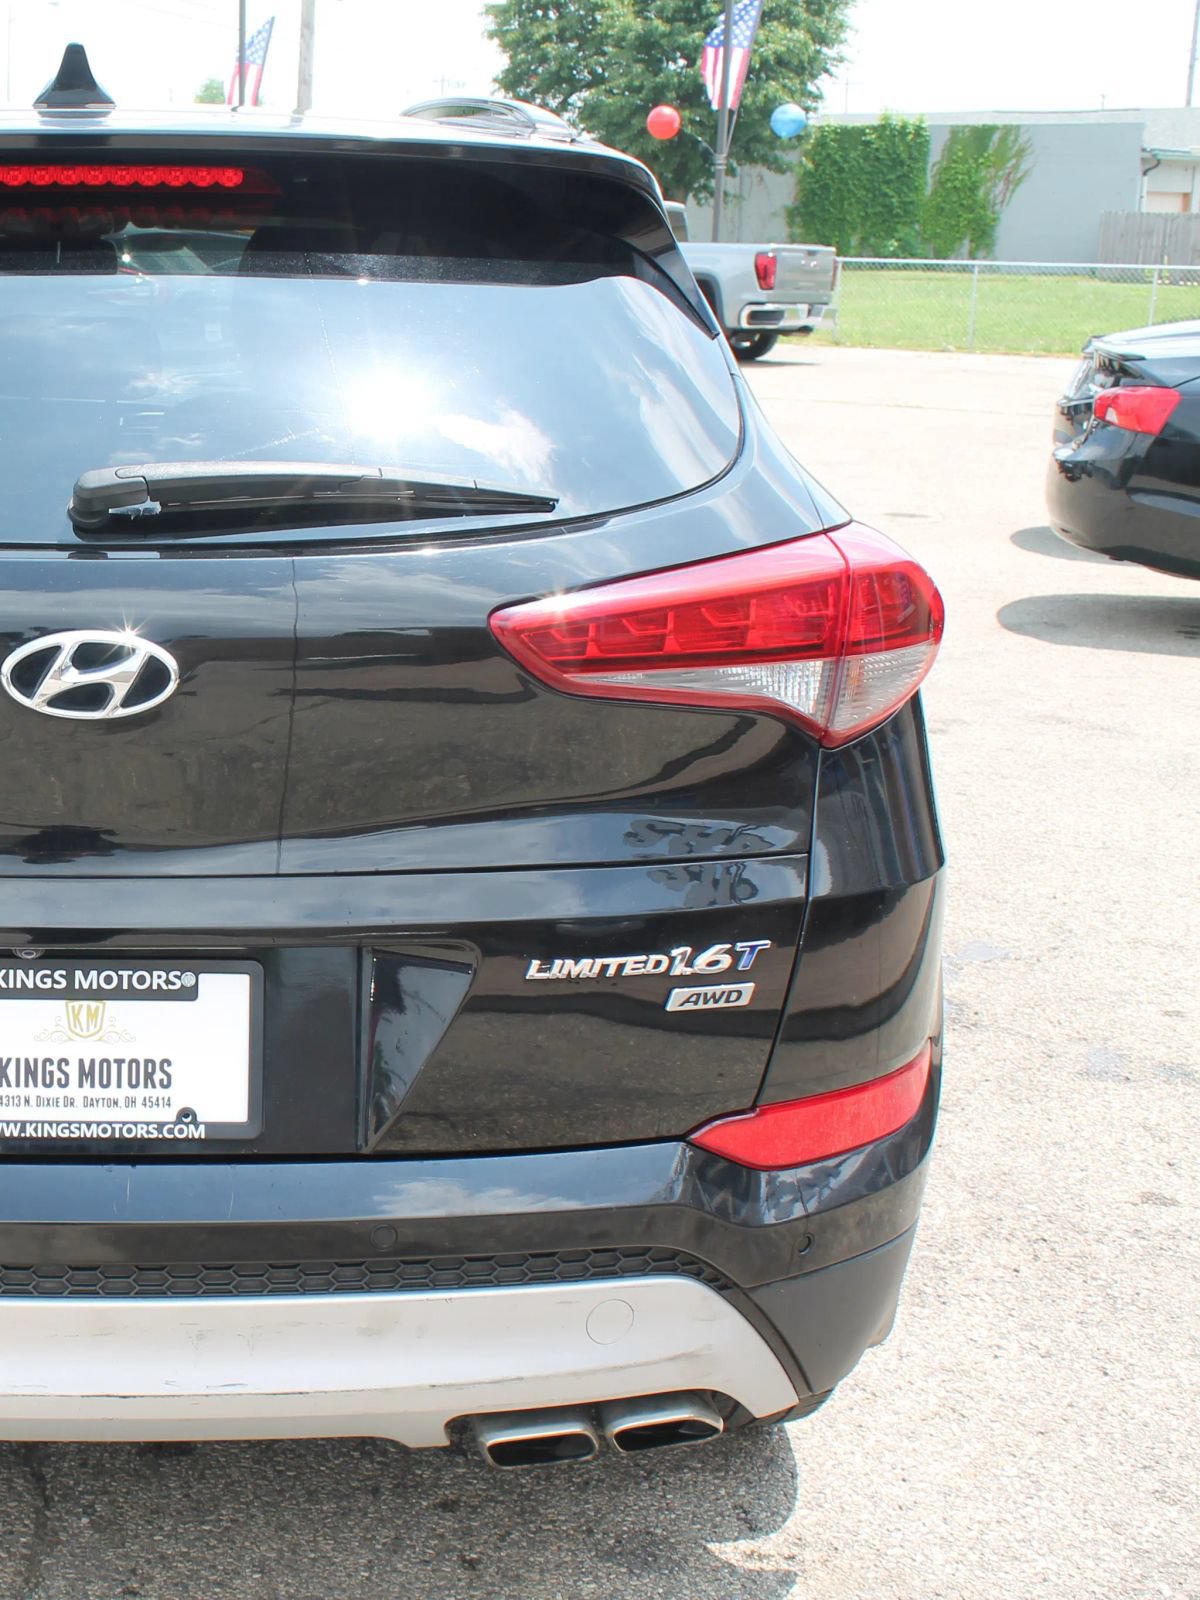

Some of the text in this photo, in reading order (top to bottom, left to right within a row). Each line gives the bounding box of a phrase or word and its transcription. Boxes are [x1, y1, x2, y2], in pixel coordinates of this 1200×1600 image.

[525, 954, 670, 980] LIMITED
[74, 970, 182, 991] MOTORS
[677, 989, 743, 1007] AWD
[71, 1003, 100, 1032] KM
[77, 1057, 172, 1089] MOTORS
[24, 1095, 33, 1108] N.
[124, 1097, 136, 1108] OH
[141, 1097, 171, 1108] 45414
